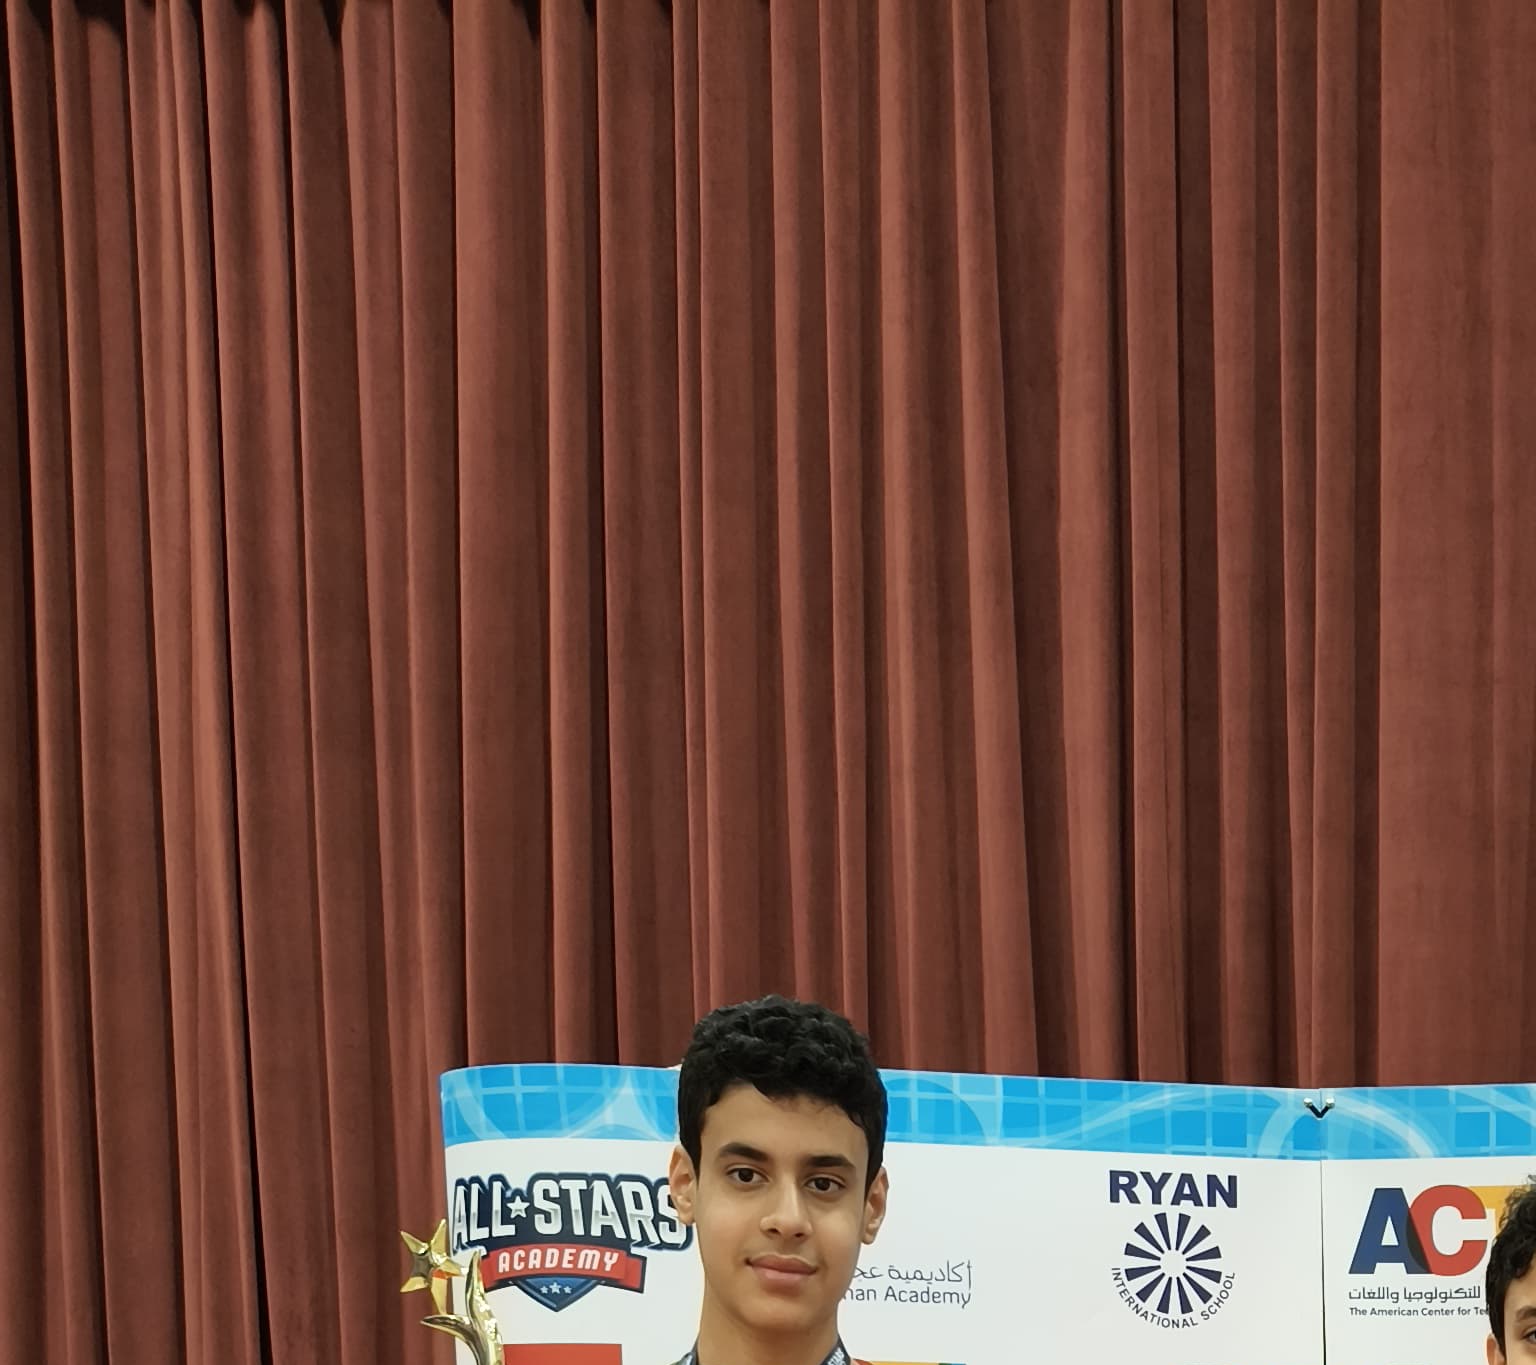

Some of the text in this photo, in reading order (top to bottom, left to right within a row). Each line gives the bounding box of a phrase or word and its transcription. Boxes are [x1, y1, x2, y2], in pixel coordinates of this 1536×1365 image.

[1108, 1169, 1239, 1210] RYAN
[453, 1178, 688, 1248] ALL STARS
[498, 1249, 620, 1273] ACADEMY
[884, 1285, 972, 1309] Academy
[1110, 1266, 1236, 1330] INTERNATIONAL SCHOOL
[1349, 1306, 1368, 1317] The
[1369, 1307, 1419, 1317] American
[1420, 1307, 1456, 1317] Center
[1457, 1306, 1472, 1316] for
